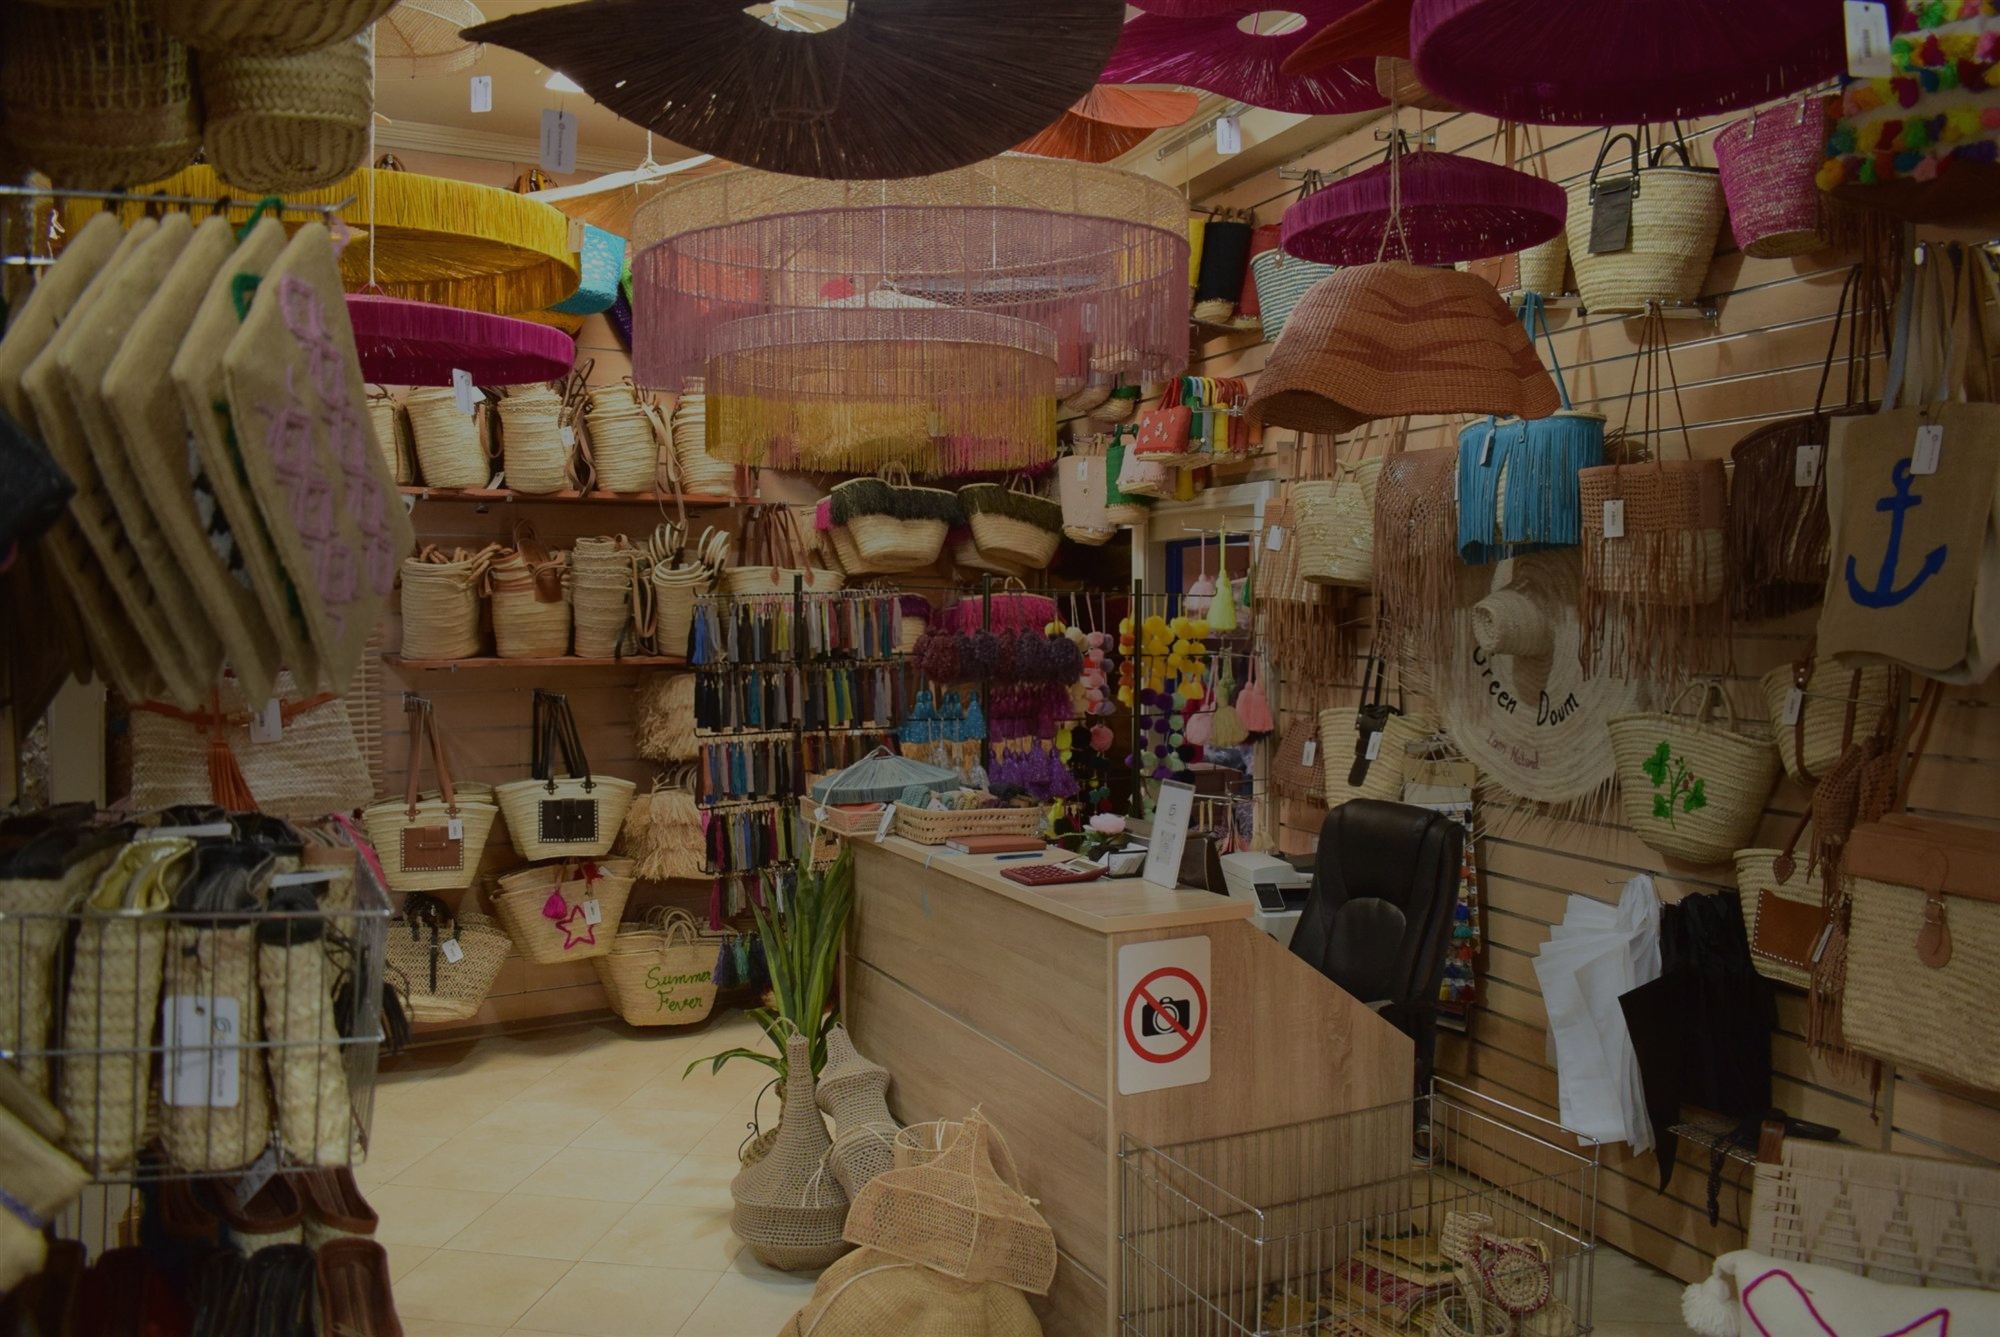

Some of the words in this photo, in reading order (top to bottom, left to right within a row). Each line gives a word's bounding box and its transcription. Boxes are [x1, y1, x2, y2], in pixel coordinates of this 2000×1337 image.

[1537, 690, 1579, 726] Doum
[645, 966, 711, 989] Summer
[657, 987, 703, 1013] Fever
